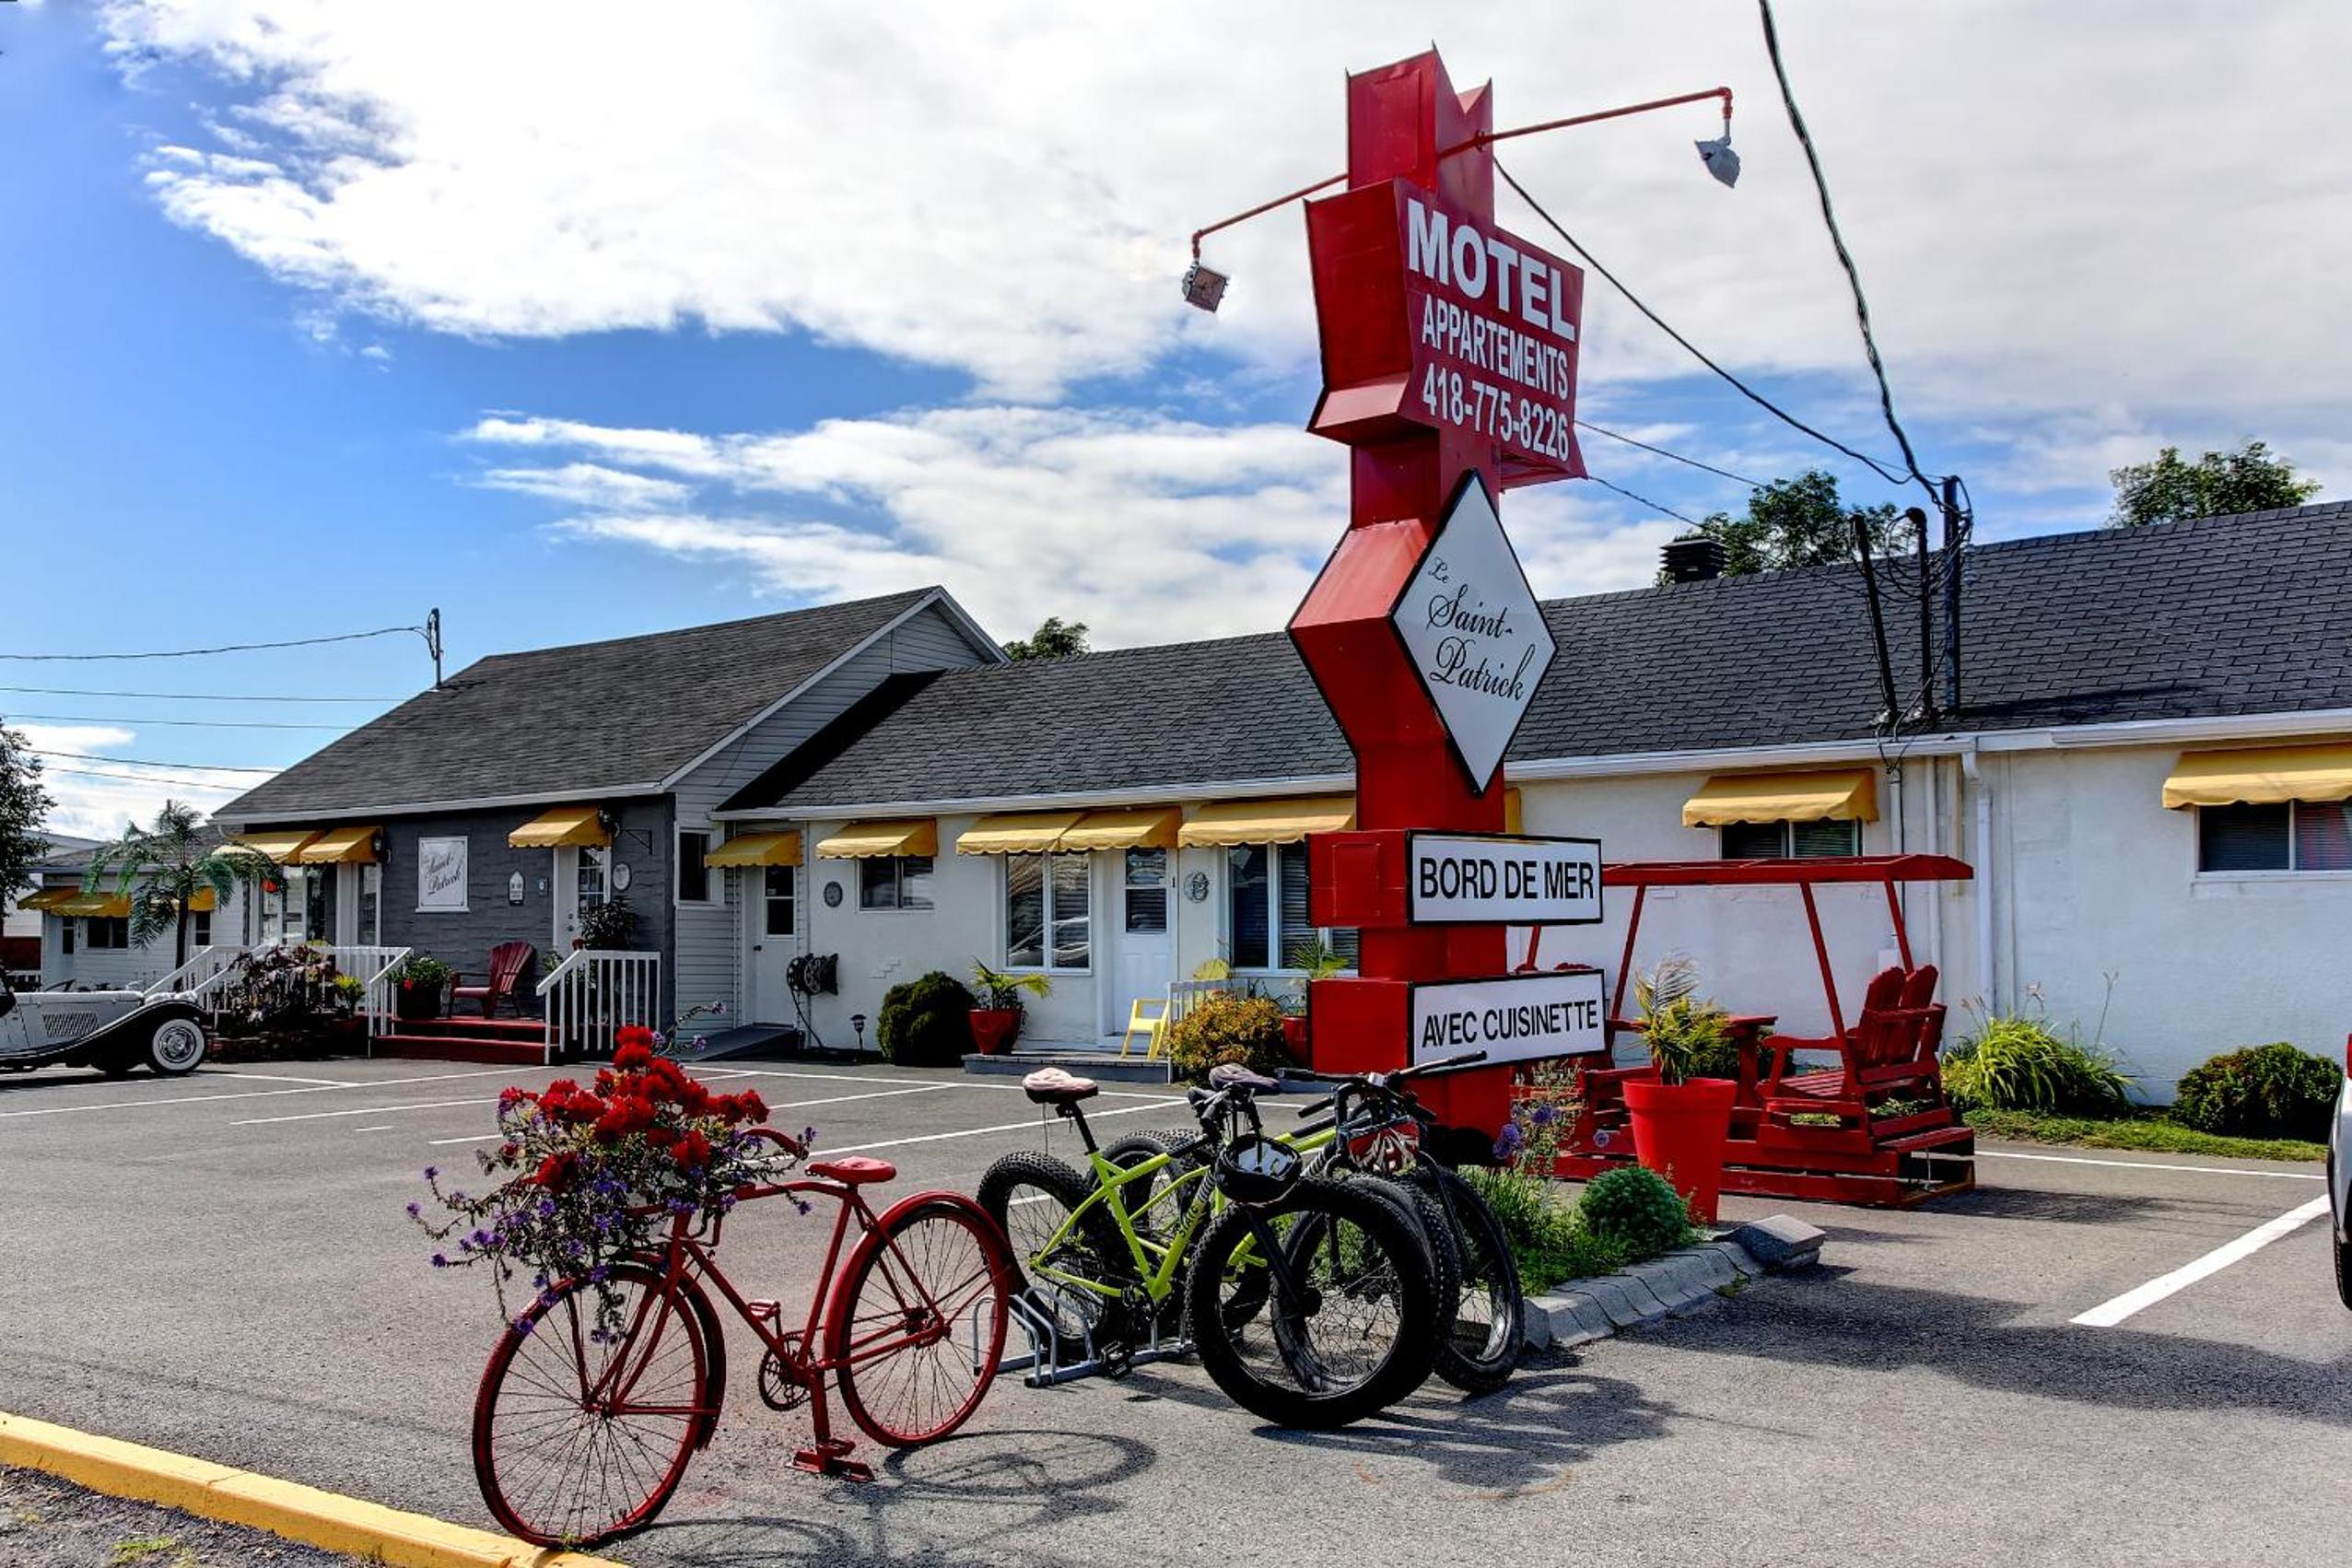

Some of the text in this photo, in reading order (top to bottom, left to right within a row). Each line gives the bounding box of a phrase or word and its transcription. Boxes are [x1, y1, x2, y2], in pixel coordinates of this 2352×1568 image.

[1408, 197, 1575, 342] MOTEL
[1422, 293, 1568, 400] APPARTEMENTS
[1422, 363, 1569, 462] 418-775-8226
[1428, 556, 1449, 583] Le
[1425, 583, 1513, 638] Saint-
[1429, 637, 1536, 701] Patrick
[1420, 857, 1595, 900] BORD DE MER
[1422, 1000, 1598, 1048] AVEC CUISINETTE
